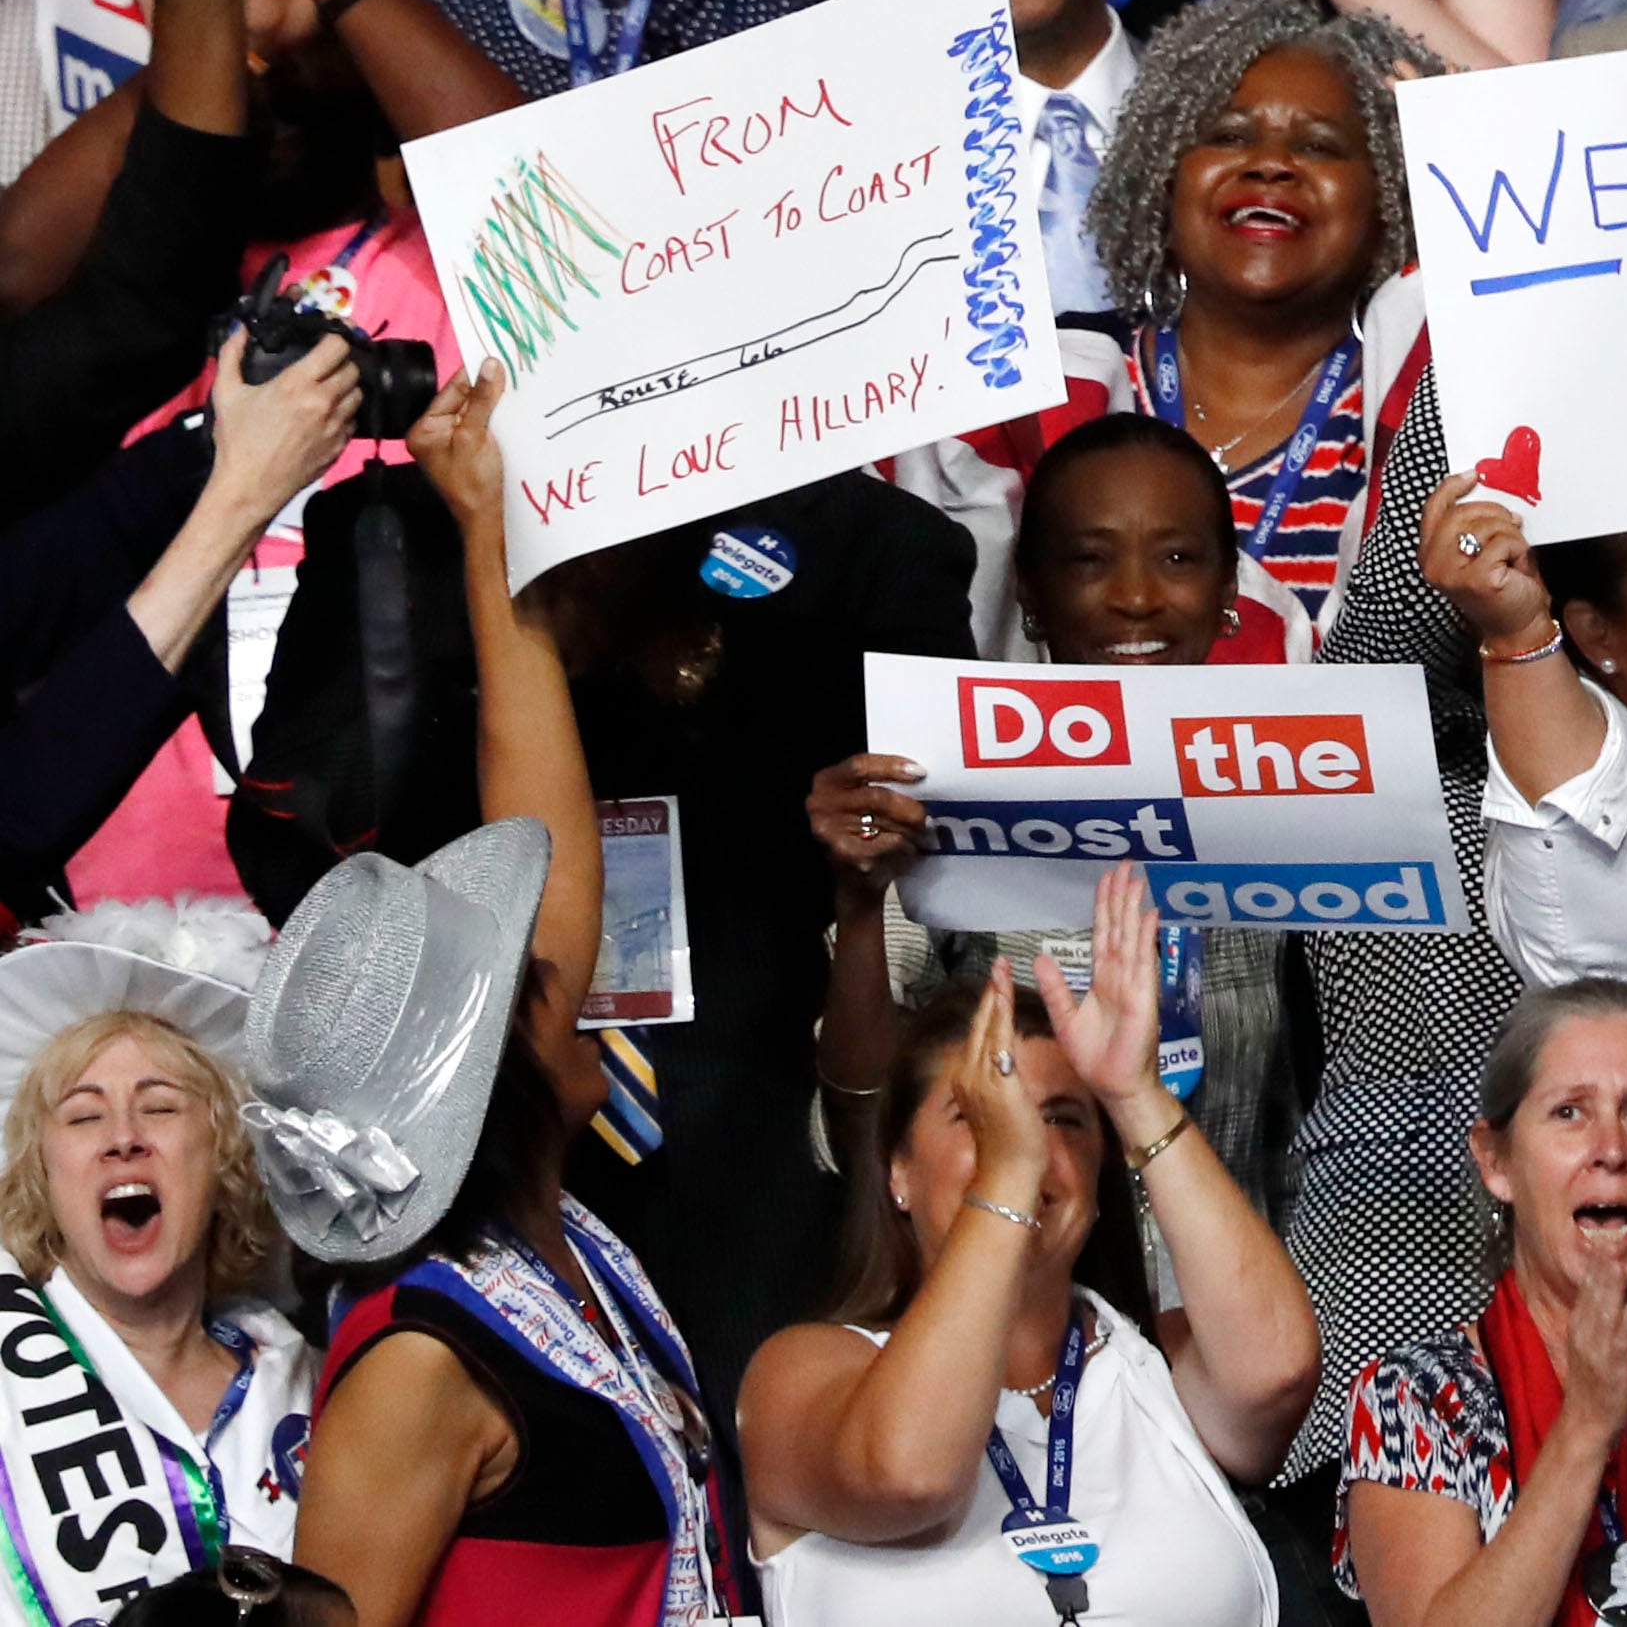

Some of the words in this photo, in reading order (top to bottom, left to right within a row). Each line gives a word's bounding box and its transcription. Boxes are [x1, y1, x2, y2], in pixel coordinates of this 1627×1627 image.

[653, 79, 853, 196] FROM
[620, 210, 740, 296] COAST
[818, 145, 941, 223] COAST
[1329, 353, 1349, 380] 2016
[1315, 380, 1337, 405] DNC
[521, 462, 602, 526] WE
[638, 421, 744, 497] LOVE
[1255, 518, 1276, 545] DNC
[714, 538, 781, 584] Delegate
[972, 685, 1112, 760] Do
[1184, 723, 1363, 793] the
[925, 804, 1183, 858] most
[1164, 866, 1431, 925] good
[1054, 1438, 1067, 1461] 2016
[1053, 1462, 1065, 1488] DNC
[1012, 1527, 1090, 1548] Delegate
[1051, 1550, 1085, 1566] 2016
